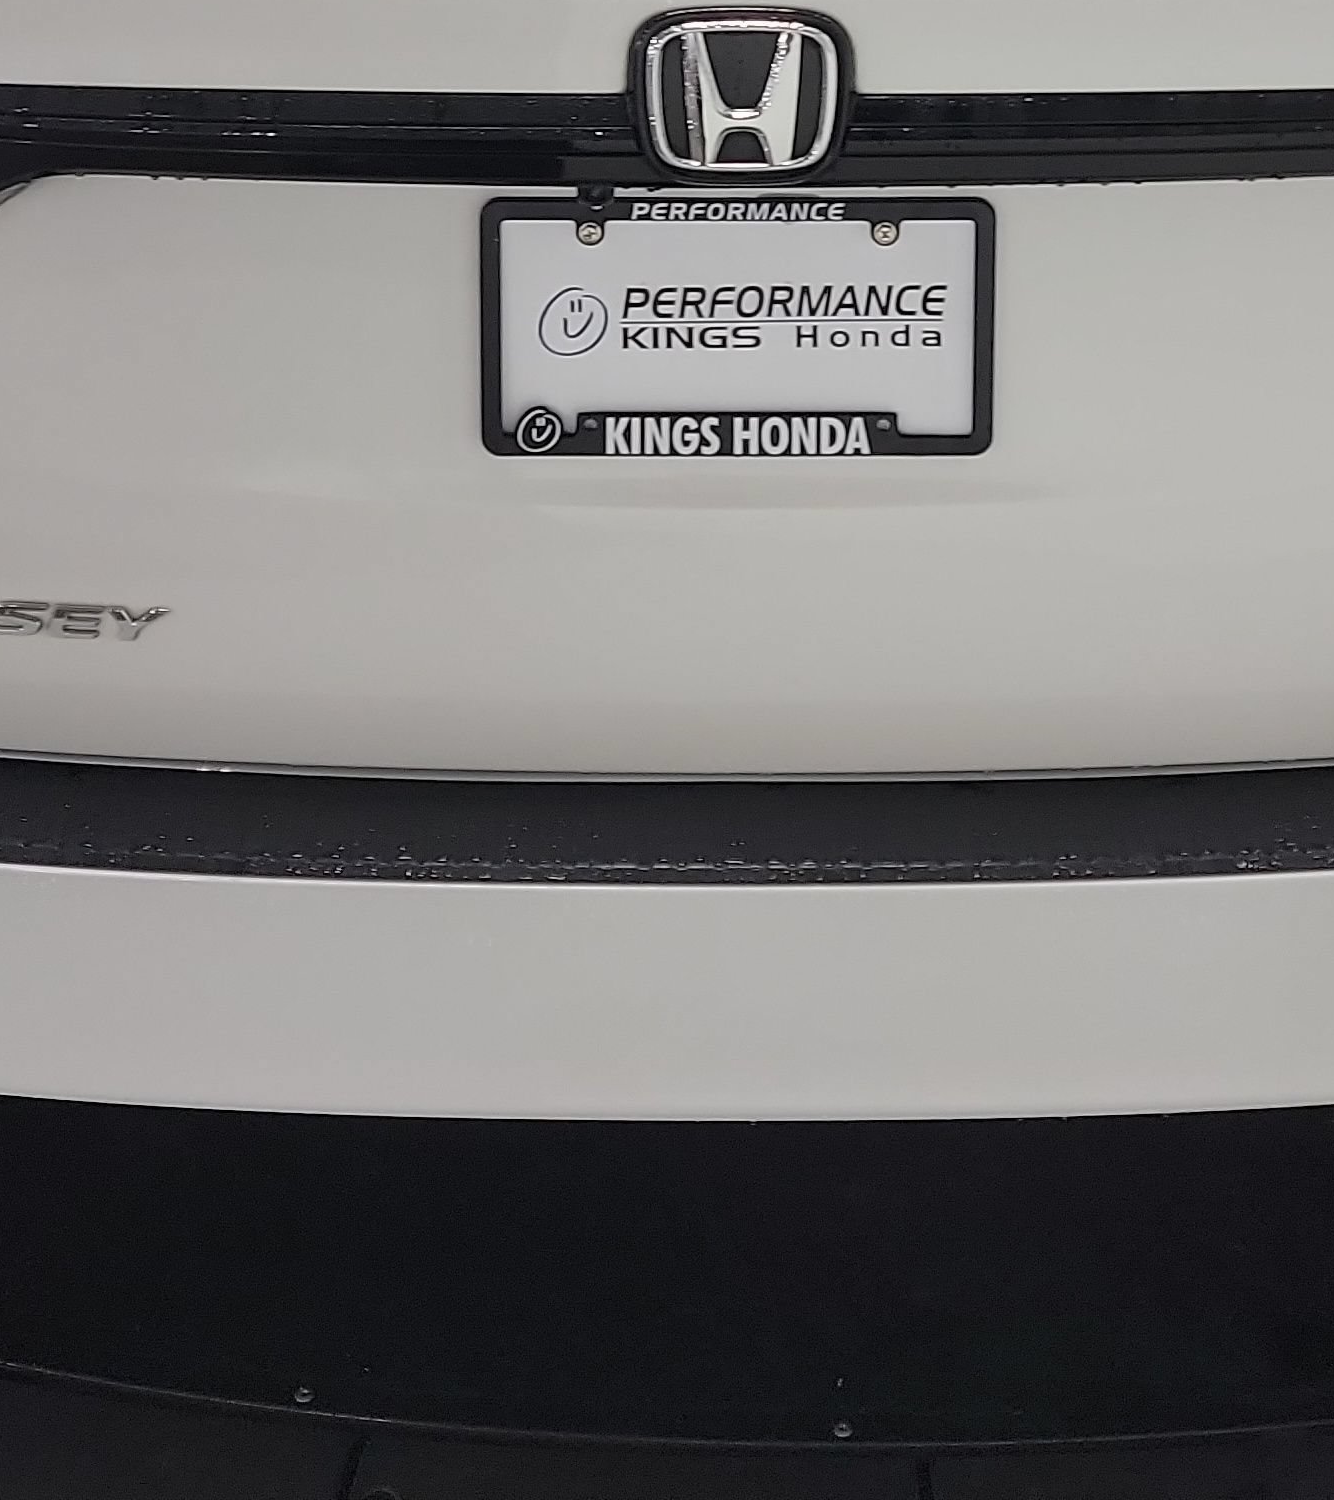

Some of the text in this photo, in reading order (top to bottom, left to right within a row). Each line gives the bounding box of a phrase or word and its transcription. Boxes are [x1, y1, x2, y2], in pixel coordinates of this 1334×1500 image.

[631, 202, 847, 222] PERFORMANCE
[622, 285, 947, 319] PERFORMANCE
[622, 324, 942, 350] KINGS Honda
[604, 416, 872, 456] KINGS HONDA
